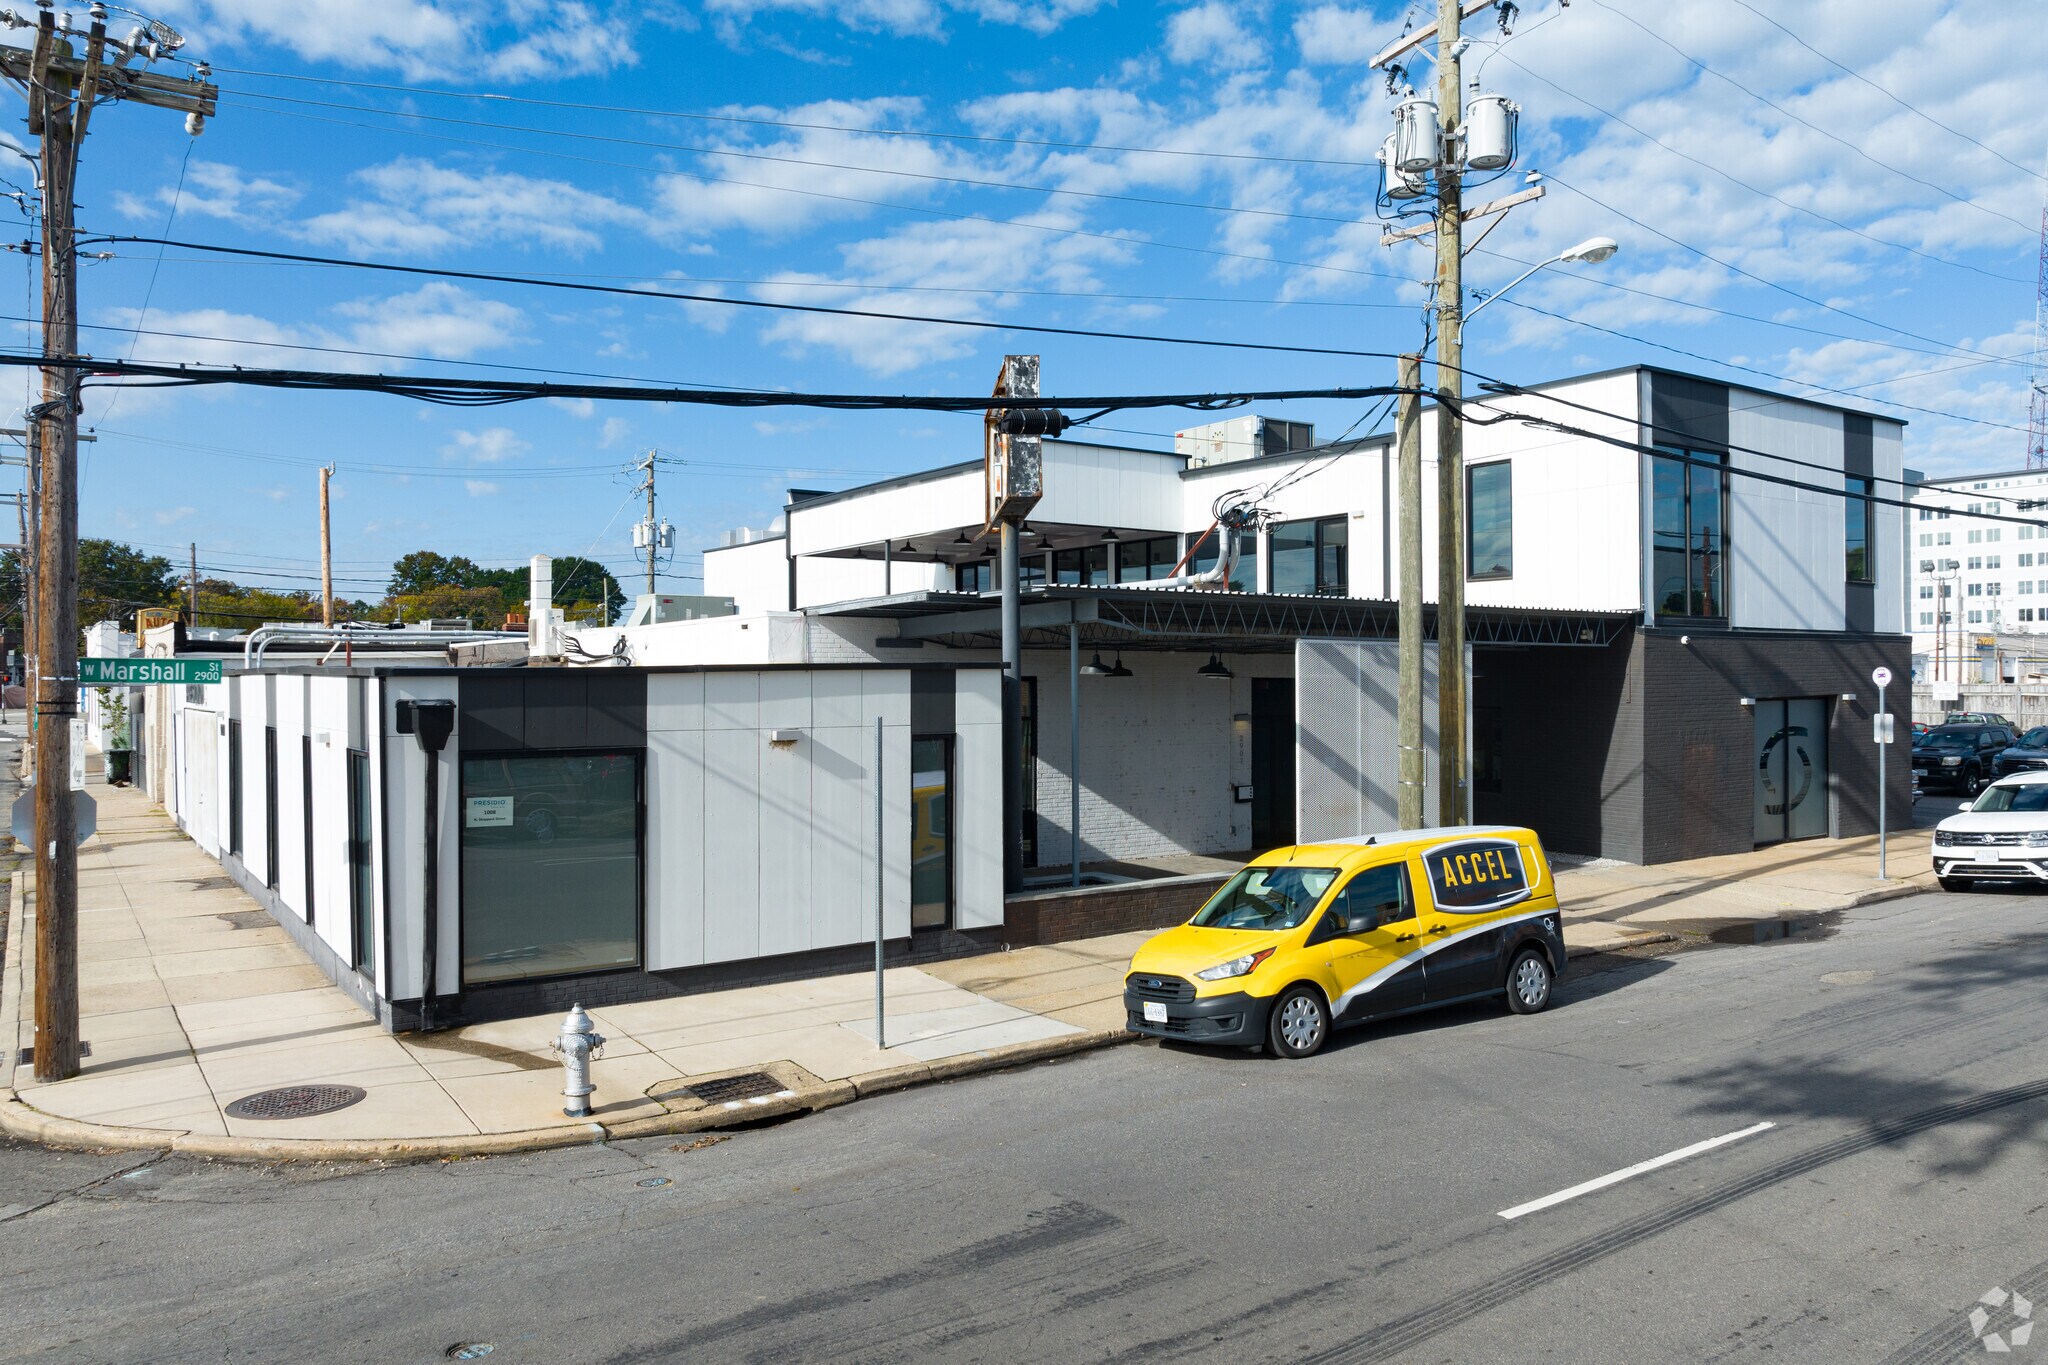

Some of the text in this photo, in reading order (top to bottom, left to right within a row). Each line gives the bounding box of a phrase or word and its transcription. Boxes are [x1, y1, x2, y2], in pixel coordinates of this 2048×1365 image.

[84, 660, 219, 681] W Marshall St
[194, 671, 219, 681] 2900
[1441, 850, 1512, 887] ACCEL
